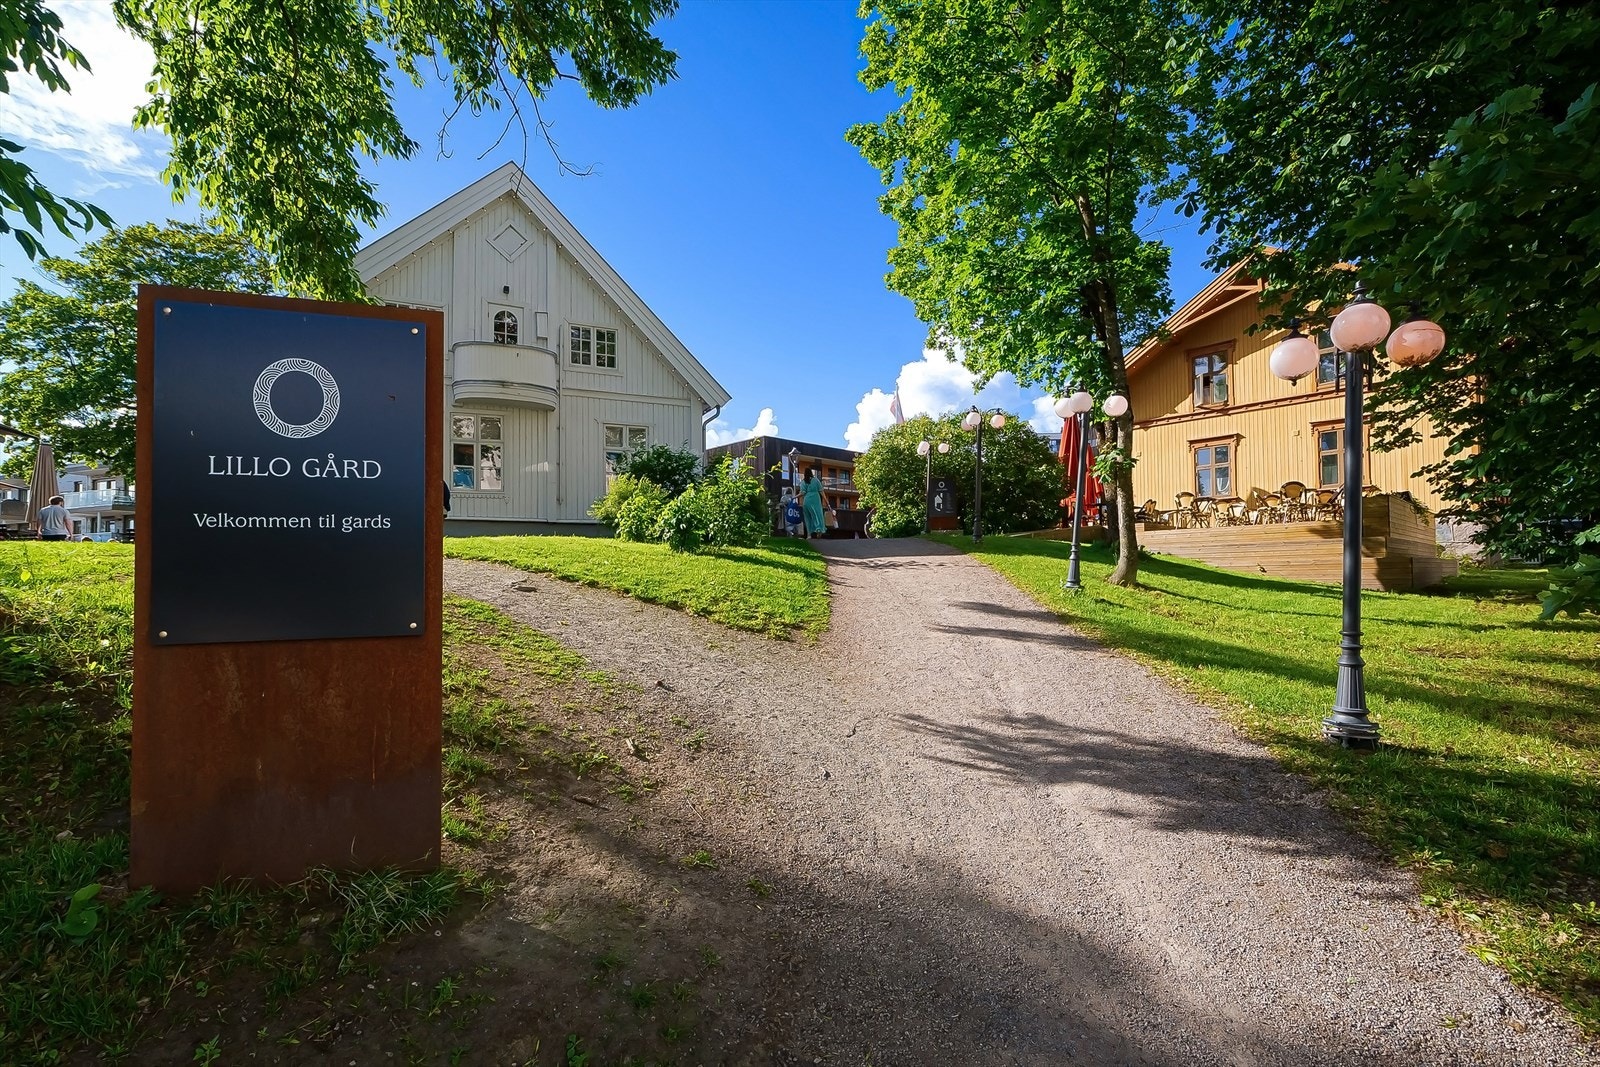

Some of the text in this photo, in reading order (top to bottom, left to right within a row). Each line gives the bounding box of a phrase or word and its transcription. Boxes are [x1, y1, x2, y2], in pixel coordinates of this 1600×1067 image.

[209, 453, 381, 478] LILLO GÅRD
[194, 513, 390, 532] Velkommen til gards
